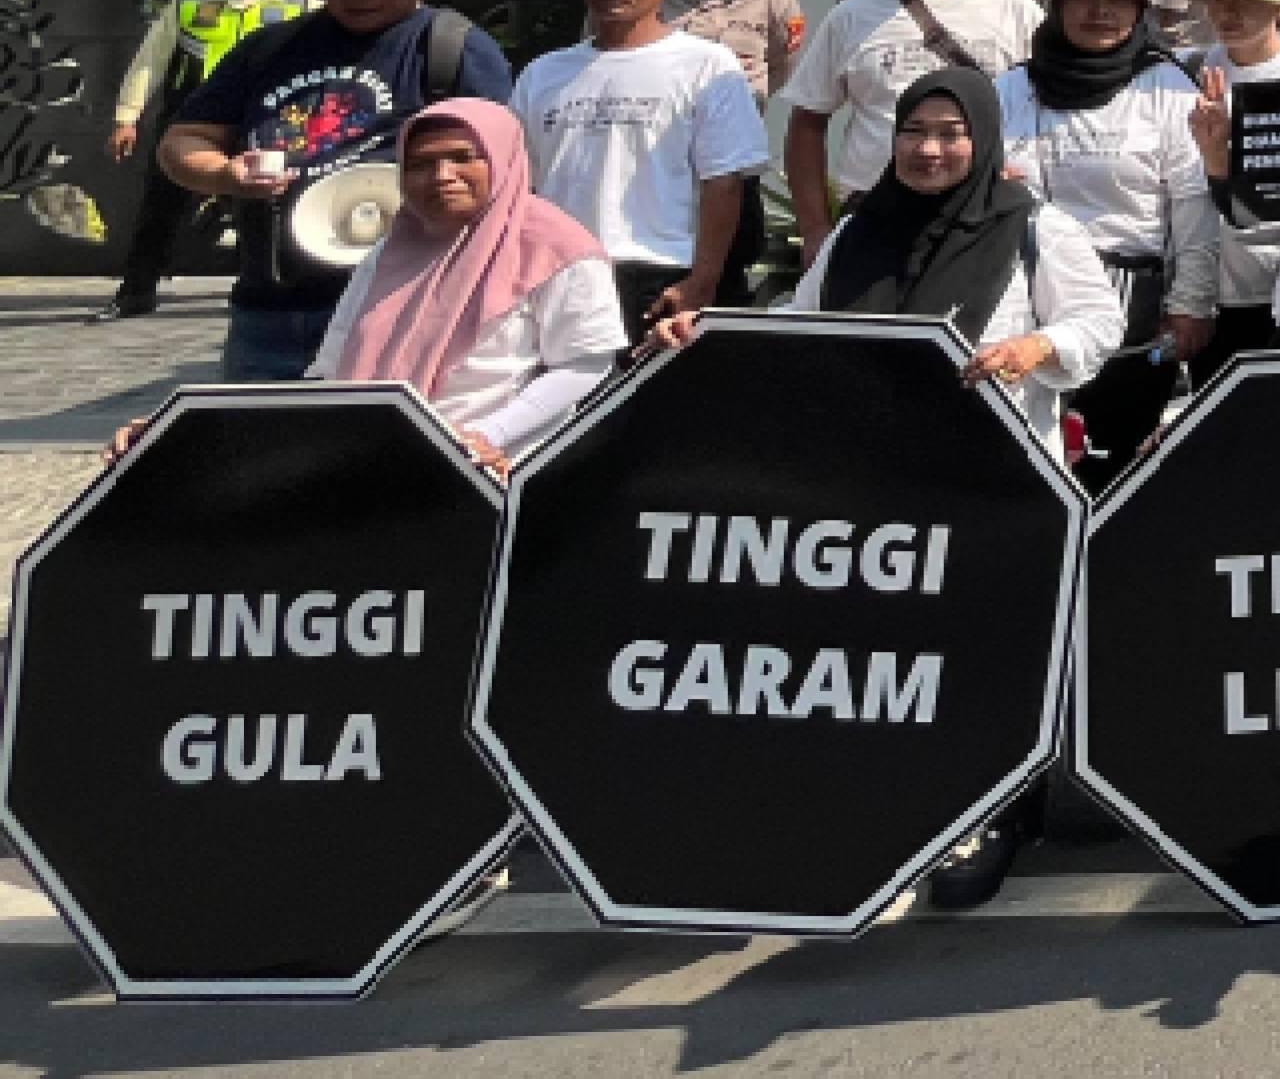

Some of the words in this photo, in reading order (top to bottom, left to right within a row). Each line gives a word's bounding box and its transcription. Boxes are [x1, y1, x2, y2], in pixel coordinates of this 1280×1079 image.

[640, 510, 950, 595] TINGGI
[141, 588, 427, 662] TINGGI
[606, 638, 946, 724] GARAM
[159, 712, 382, 786] GULA
